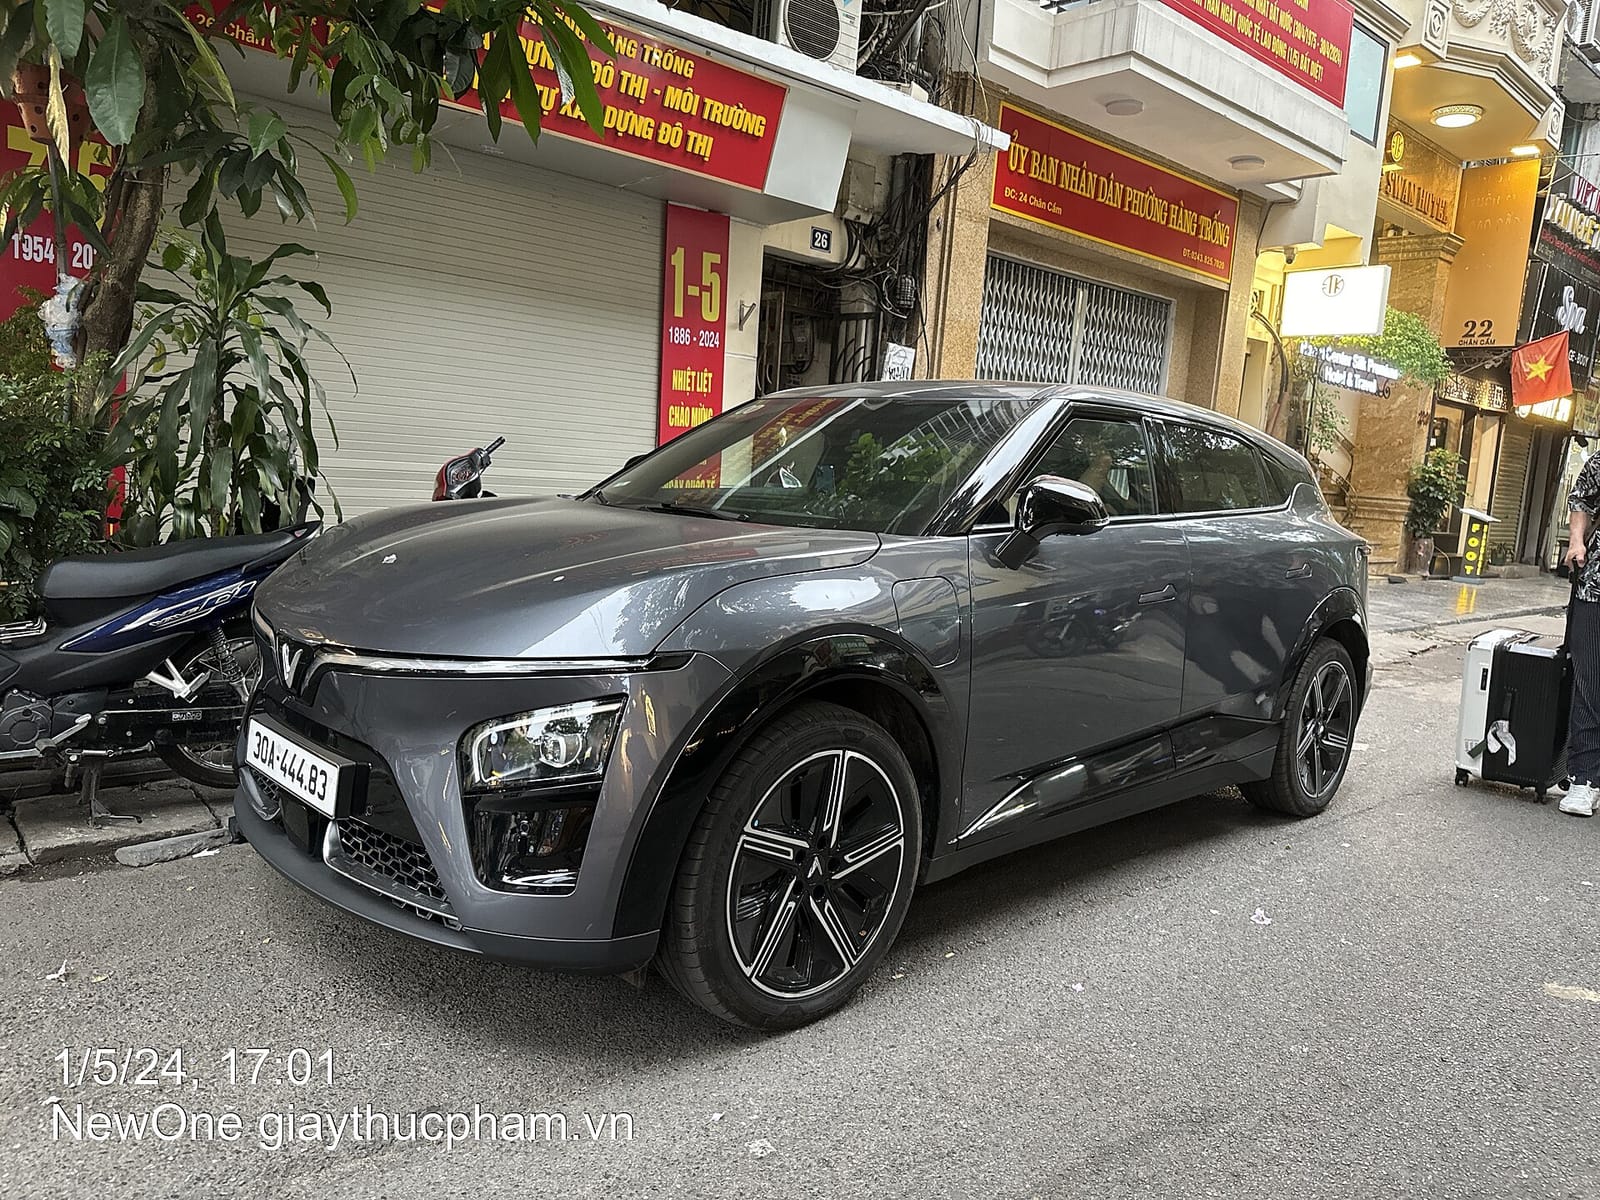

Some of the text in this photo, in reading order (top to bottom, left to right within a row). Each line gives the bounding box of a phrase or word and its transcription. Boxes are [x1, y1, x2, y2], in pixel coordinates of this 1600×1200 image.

[602, 26, 696, 79] ÀNG TRỐNG
[619, 70, 649, 104] THỊ
[663, 85, 701, 116] MÔI
[703, 97, 767, 138] TRƯỜNG
[603, 105, 656, 141] DỰNG
[657, 122, 684, 148] ĐÔ
[686, 130, 714, 161] THỊ
[1004, 187, 1018, 200] ĐC:
[1018, 191, 1028, 203] 24
[1008, 129, 1230, 248] ỦY BAN NHÂN DÂN PHƯỜNG HÀNG TRỐNG
[11, 232, 55, 264] 1954
[814, 231, 829, 249] 26
[671, 246, 721, 322] 1-5
[669, 326, 691, 345] 1886
[698, 330, 720, 348] 2024
[1462, 319, 1494, 338] 22
[672, 366, 713, 397] NHIỆT LIỆT
[1325, 365, 1347, 386] Hotel
[668, 401, 690, 428] CHÀO
[252, 731, 328, 801] 30A-444.83
